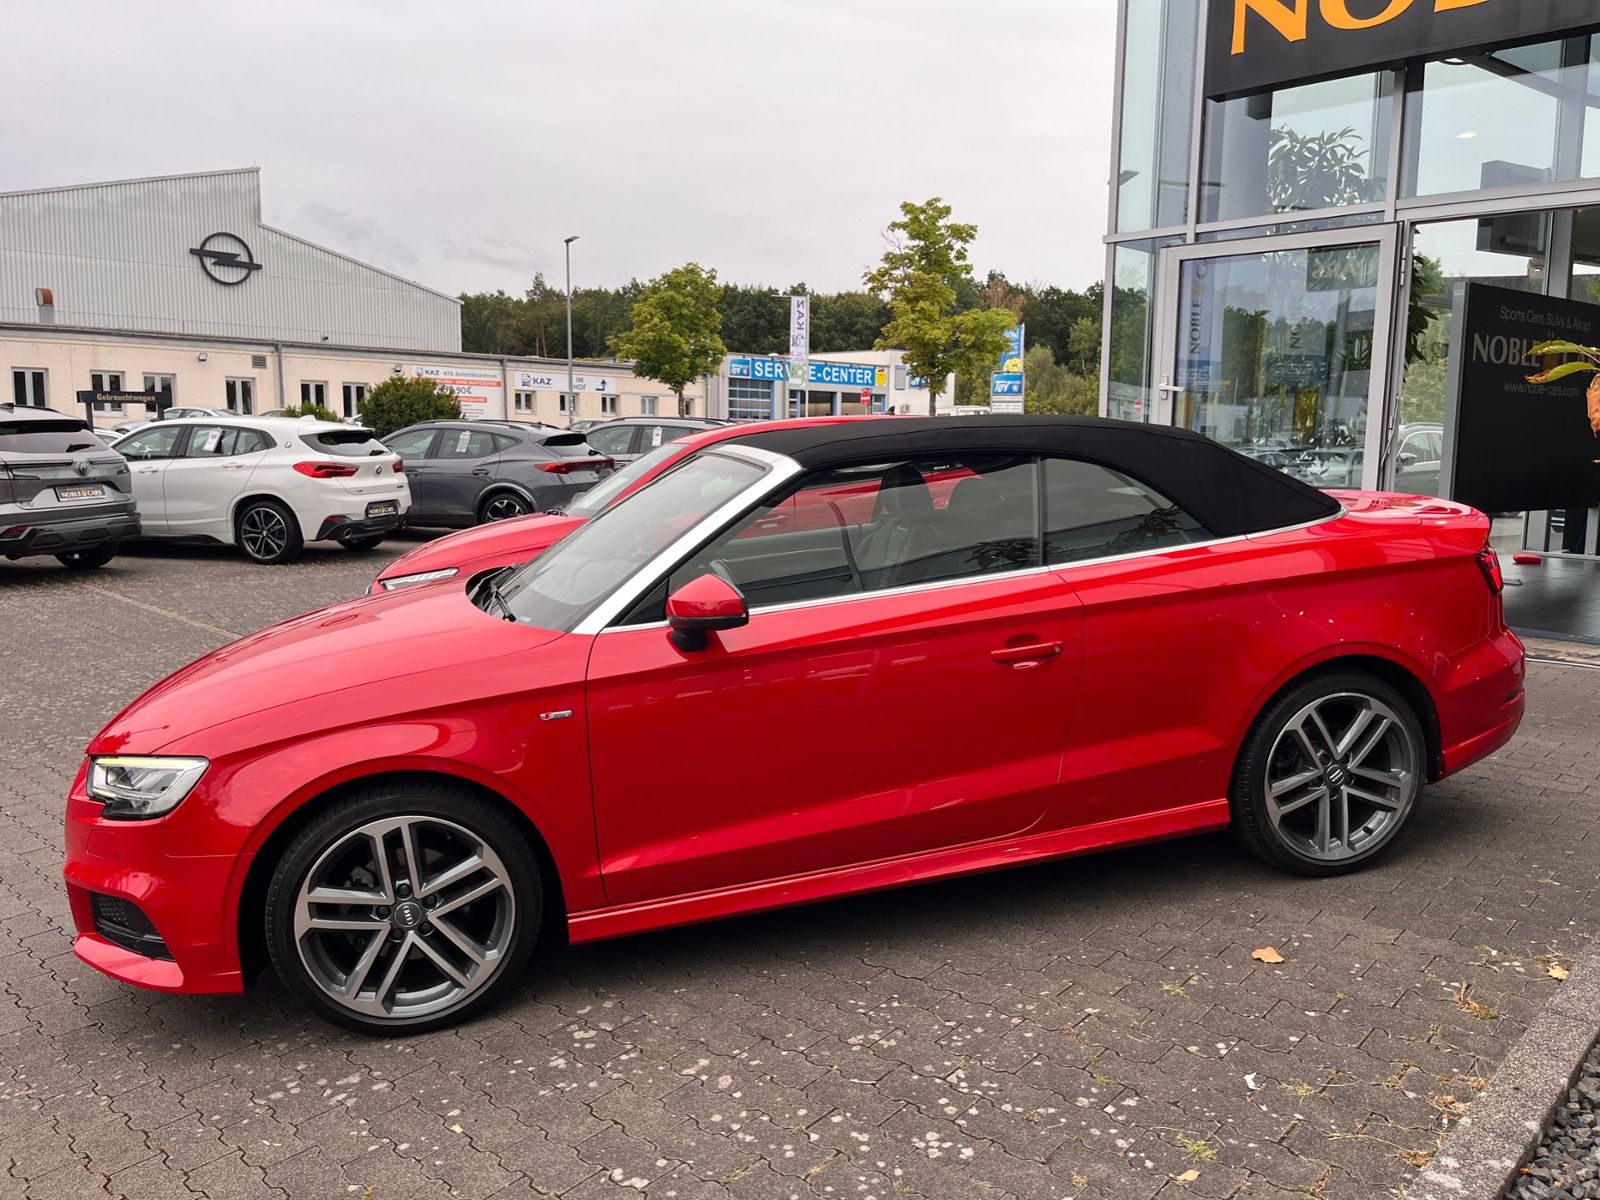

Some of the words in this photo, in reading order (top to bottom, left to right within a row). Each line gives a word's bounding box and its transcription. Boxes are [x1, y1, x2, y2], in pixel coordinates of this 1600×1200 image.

[1500, 305, 1526, 322] Sports
[754, 361, 872, 384] SERVE-CENTER
[533, 377, 552, 386] KAZ
[96, 393, 156, 403] Gebrauchtwagen
